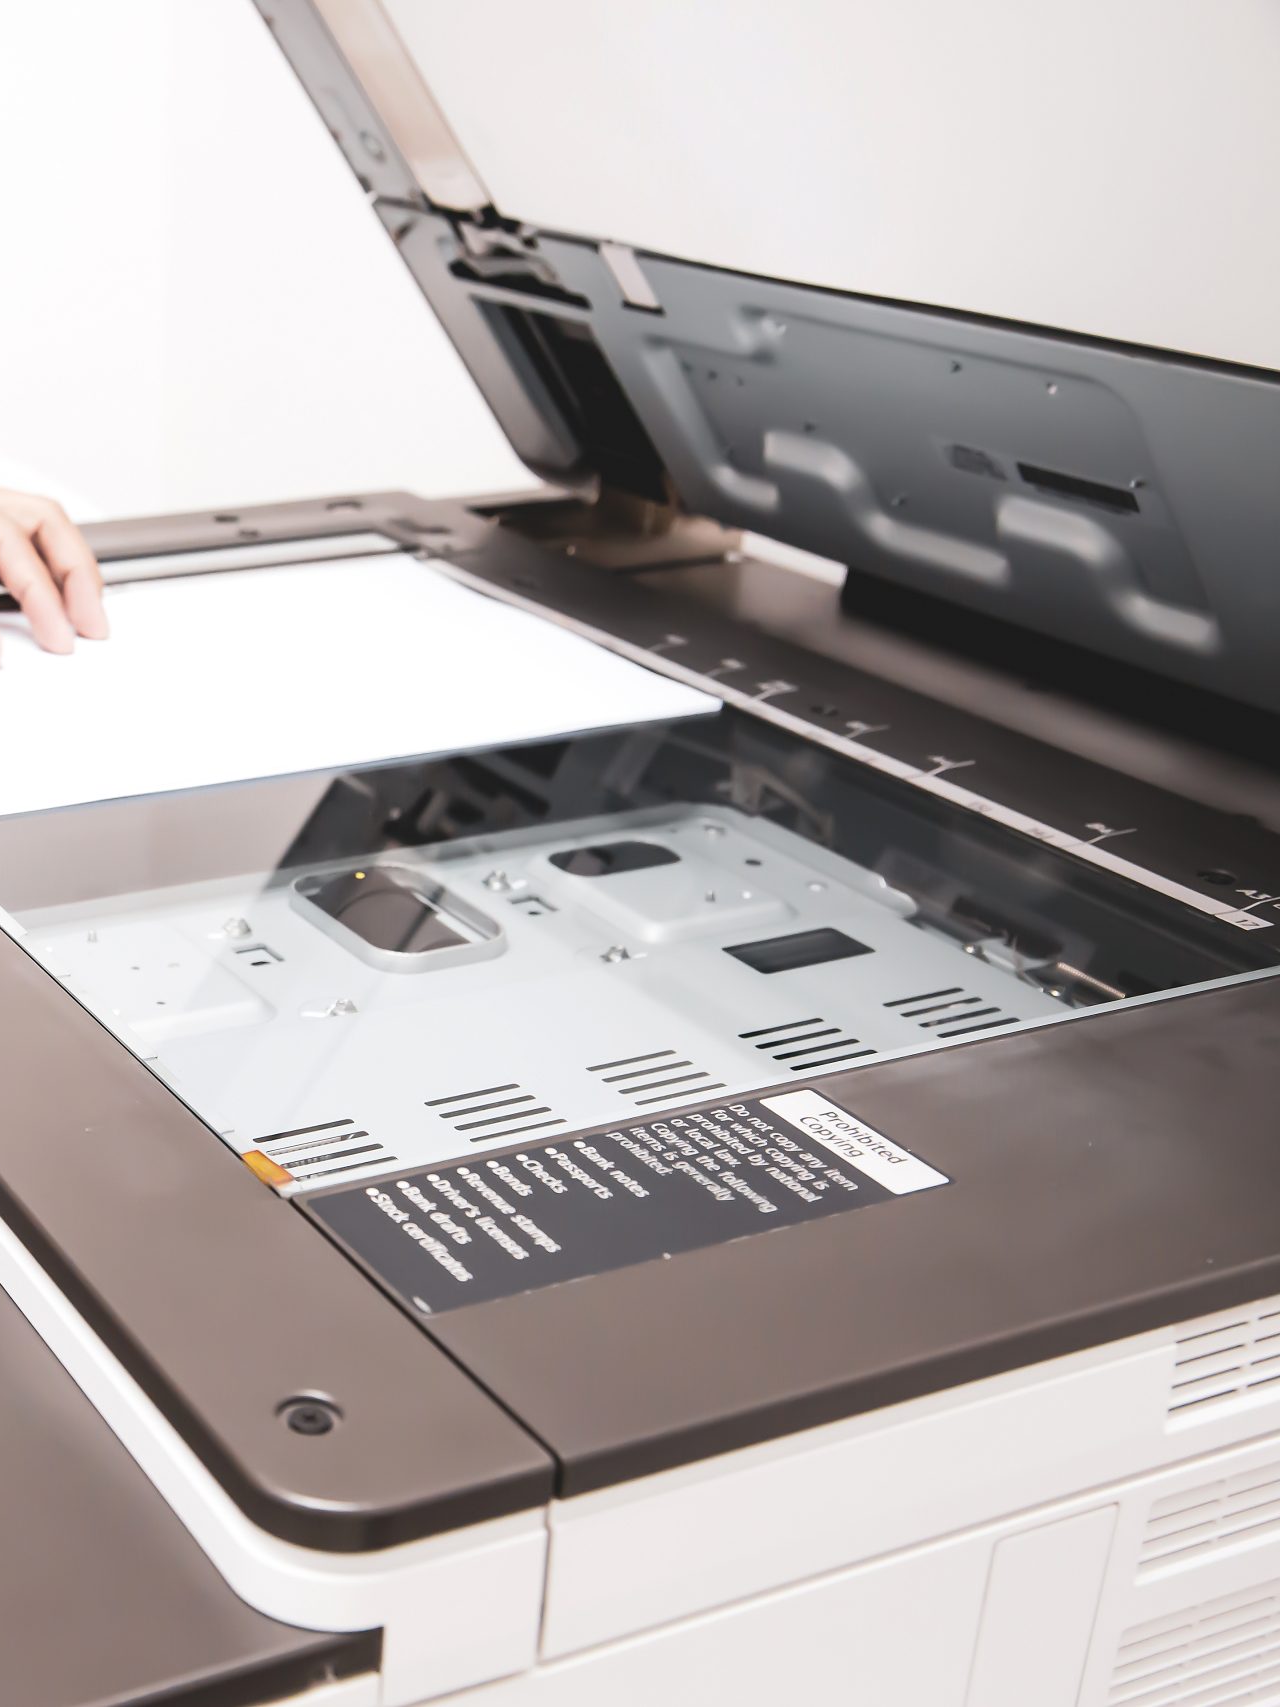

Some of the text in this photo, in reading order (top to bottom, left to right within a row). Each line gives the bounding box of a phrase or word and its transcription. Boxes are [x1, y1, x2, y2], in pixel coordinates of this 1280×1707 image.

[606, 1131, 674, 1177] prohibited:
[629, 1126, 736, 1202] items is generally
[670, 1118, 743, 1168] or local law.
[686, 1114, 824, 1204] prohibited by national
[710, 1109, 830, 1192] for which copying is
[728, 1104, 860, 1192] Do not copy any item
[799, 1116, 865, 1158] Copying
[818, 1110, 909, 1166] Prohibited
[492, 1165, 534, 1198] Bonds
[522, 1159, 568, 1194] Checks
[550, 1153, 614, 1200] Passports
[578, 1147, 650, 1198] Bank notes
[650, 1122, 779, 1214] Copying the following
[372, 1193, 474, 1282] Stock certificates
[406, 1185, 472, 1245] Bank drafts
[434, 1179, 530, 1260] Driver's licenses
[463, 1171, 562, 1254] Revenue stamps
